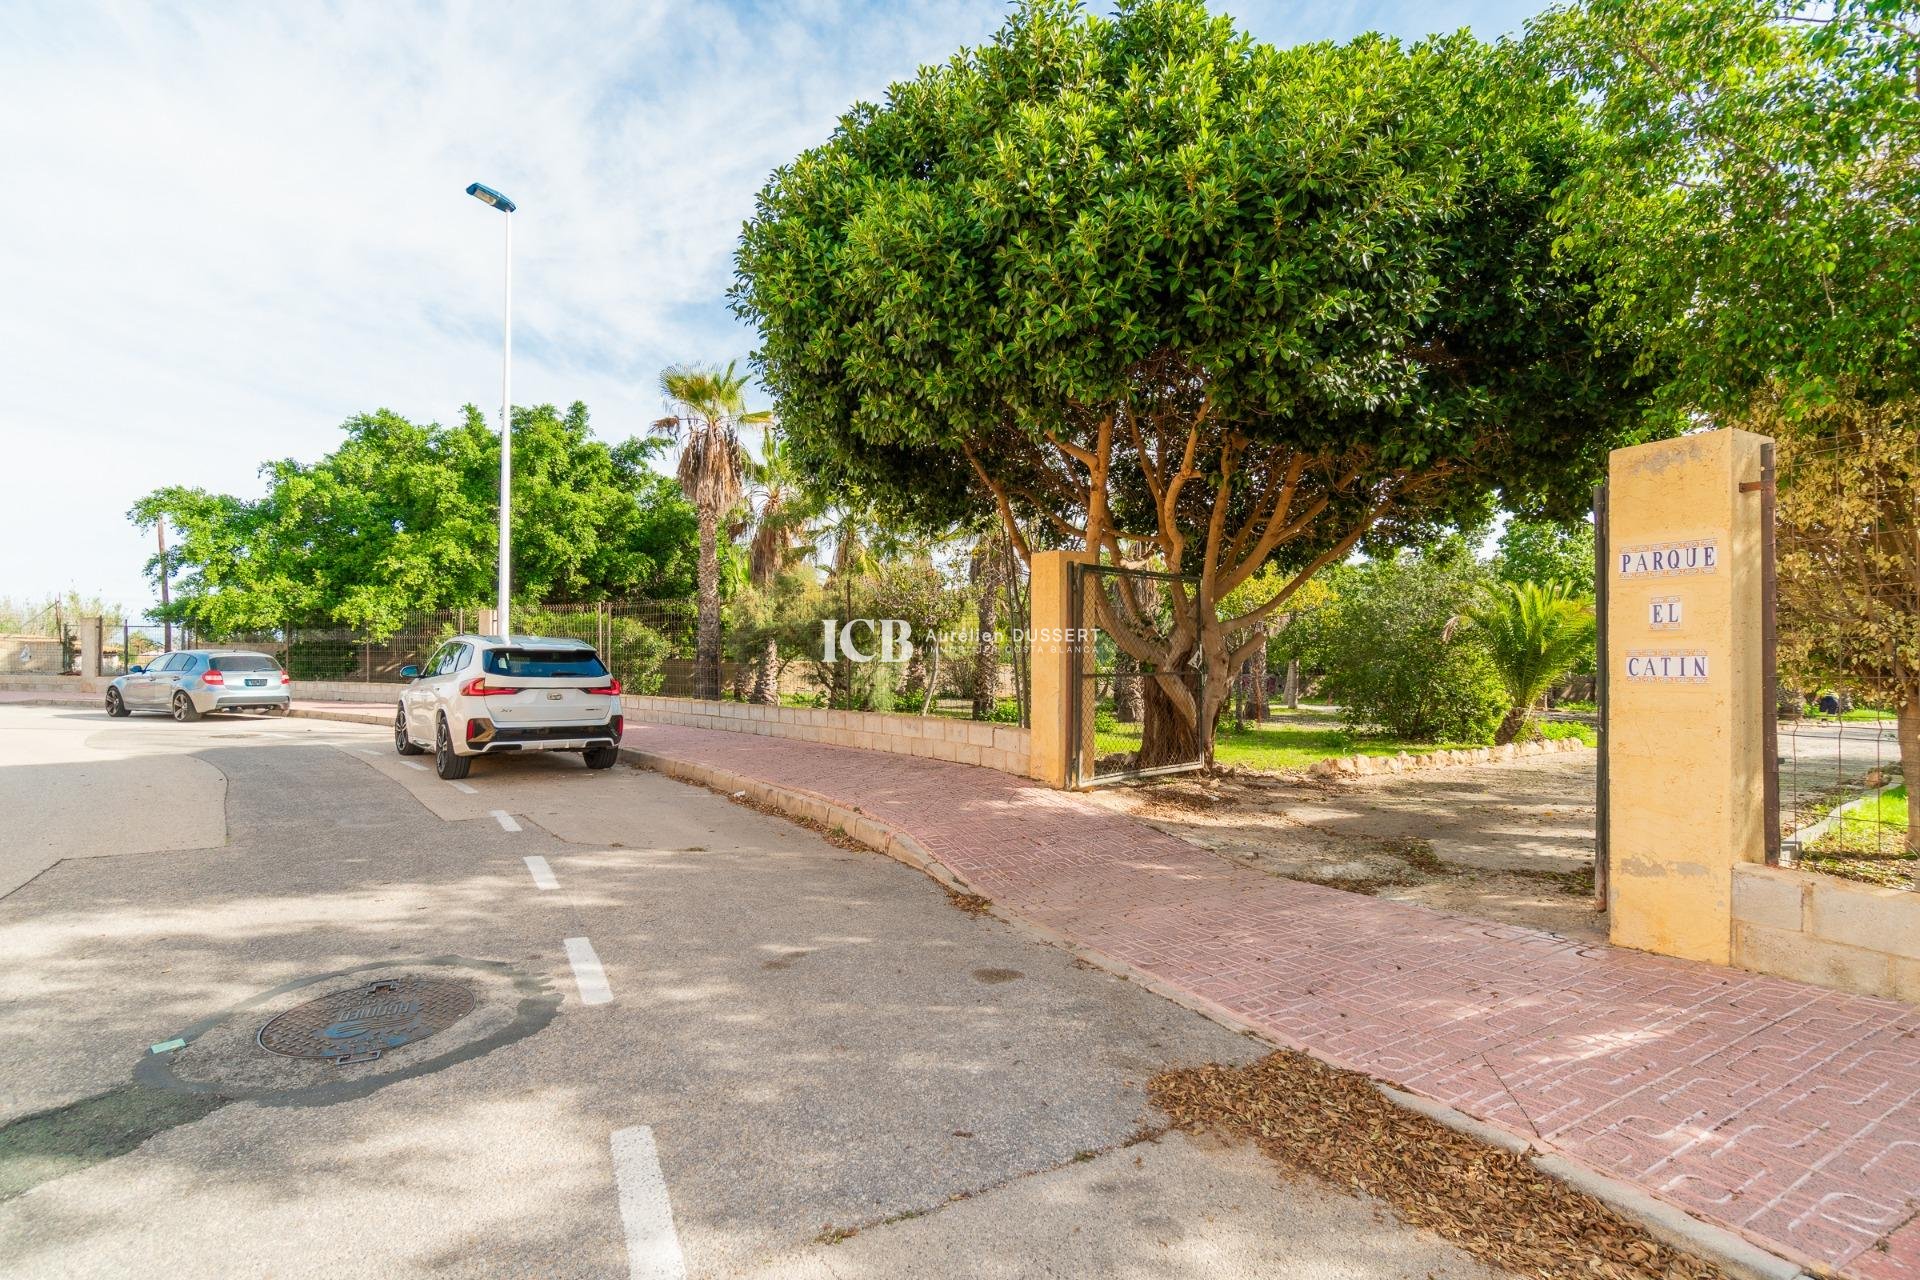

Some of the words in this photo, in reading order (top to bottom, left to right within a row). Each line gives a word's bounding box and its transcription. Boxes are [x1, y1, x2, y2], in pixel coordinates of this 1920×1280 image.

[1622, 546, 1715, 573] PARQUE
[1653, 603, 1679, 624] EL
[1628, 657, 1707, 677] CATIN
